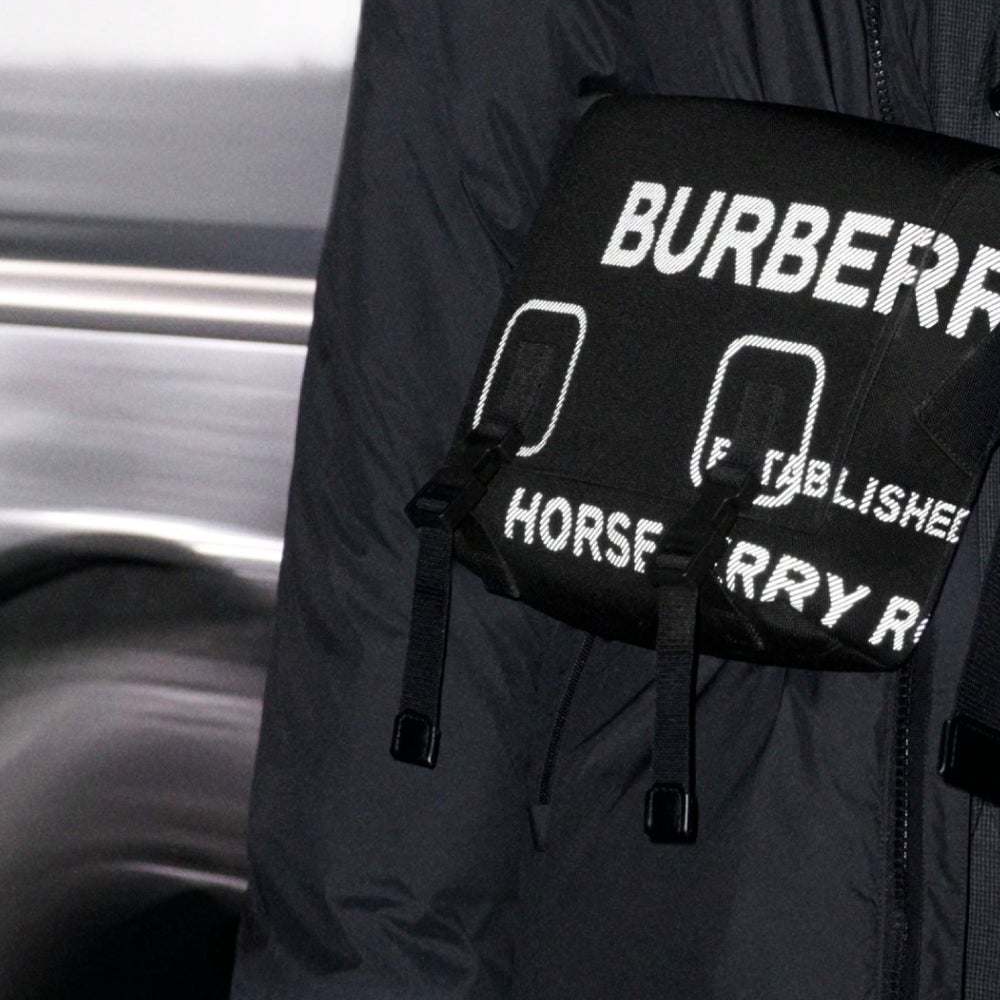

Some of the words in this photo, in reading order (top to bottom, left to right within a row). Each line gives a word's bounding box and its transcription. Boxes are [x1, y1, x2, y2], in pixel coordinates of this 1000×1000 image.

[705, 436, 970, 543] ETABLISHE
[504, 487, 871, 628] HORSERRY
[868, 596, 934, 651] R
